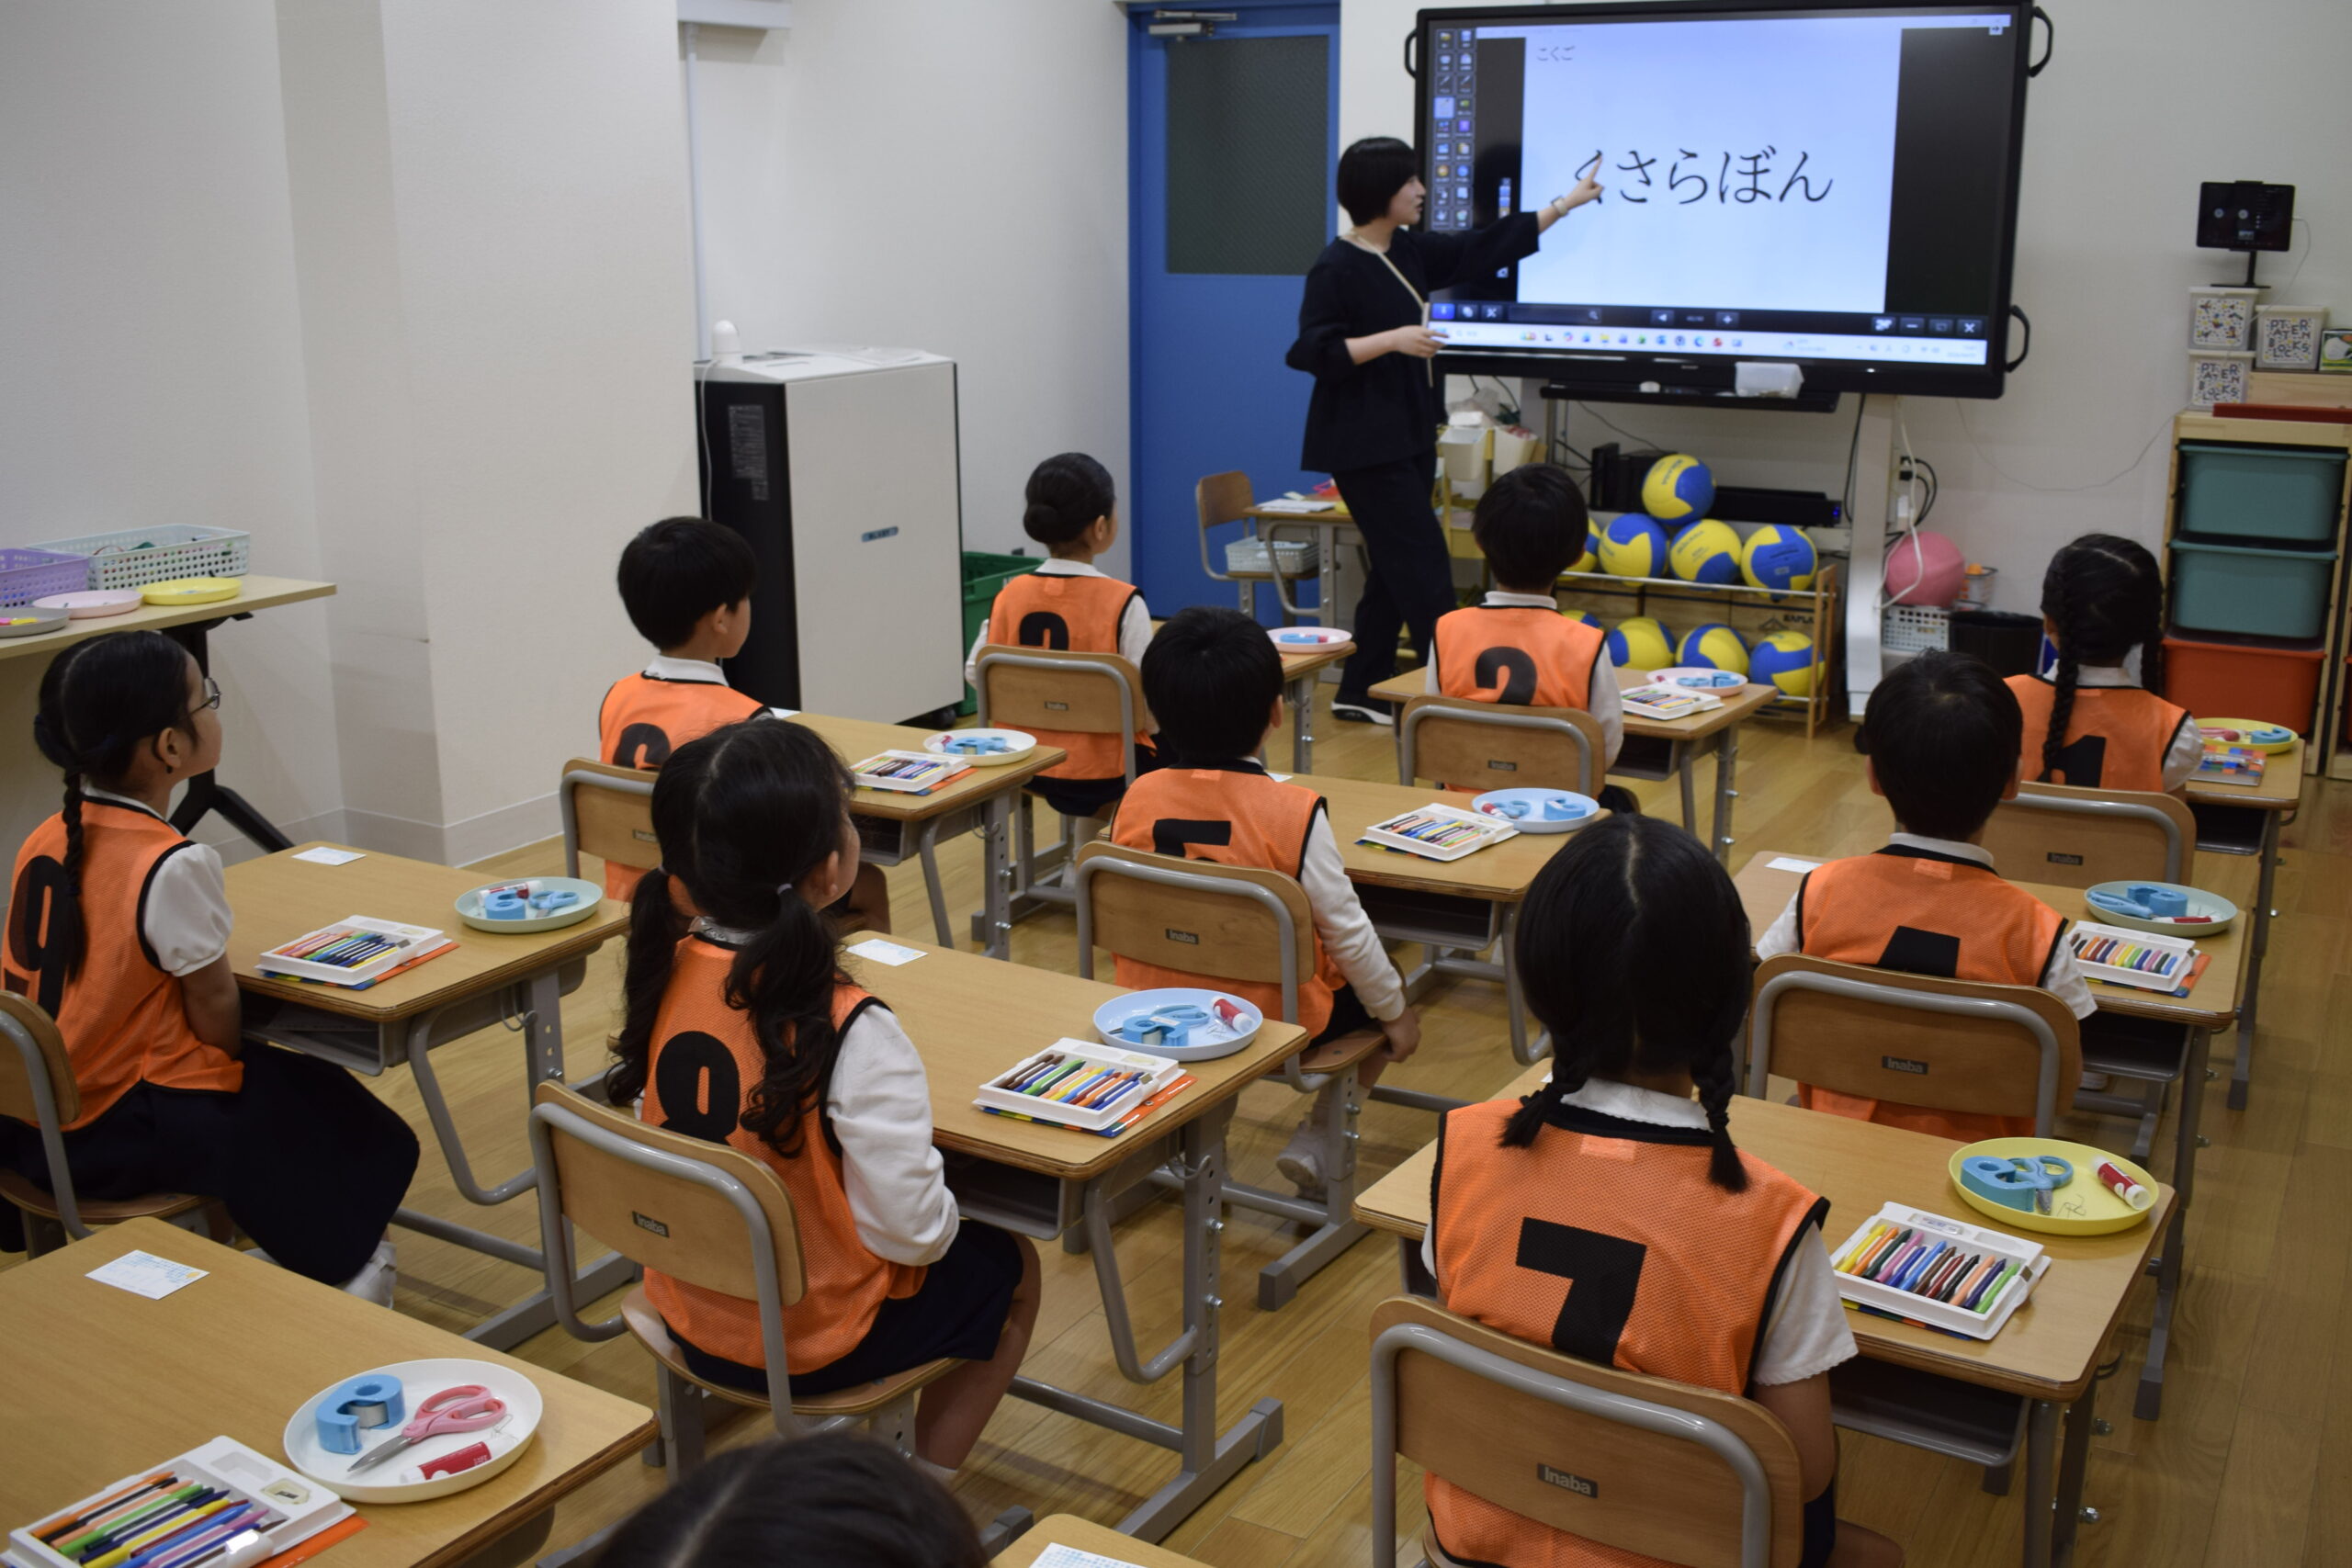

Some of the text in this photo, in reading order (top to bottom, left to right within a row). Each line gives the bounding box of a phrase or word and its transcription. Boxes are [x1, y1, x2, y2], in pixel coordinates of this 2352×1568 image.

[1536, 45, 1577, 62] こくご
[1574, 145, 1833, 205] くさらぼん
[1475, 646, 1538, 705] 2
[4, 854, 74, 1023] 9
[1887, 1056, 1924, 1074] Inaba
[636, 1213, 666, 1235] Inaba
[1515, 1216, 1647, 1365] 7
[1544, 1465, 1592, 1495] Inaba
